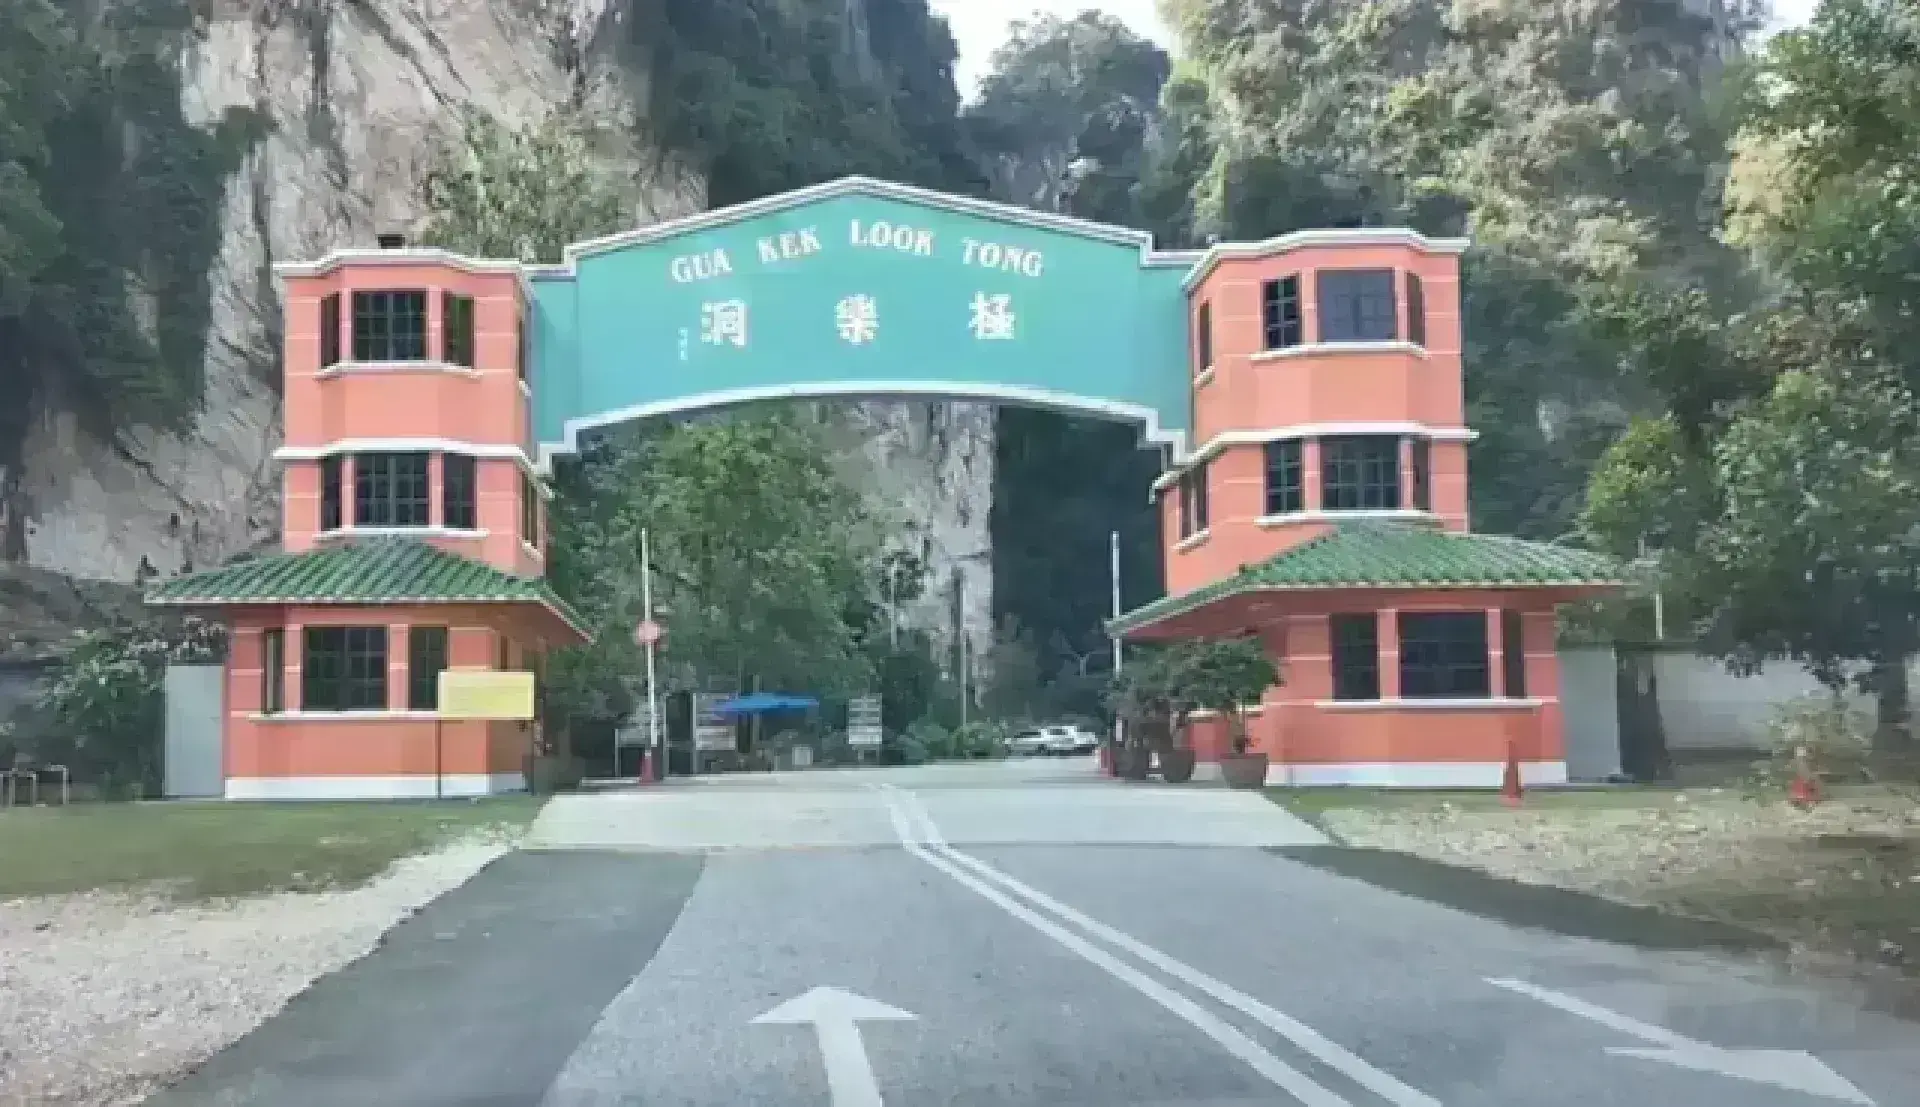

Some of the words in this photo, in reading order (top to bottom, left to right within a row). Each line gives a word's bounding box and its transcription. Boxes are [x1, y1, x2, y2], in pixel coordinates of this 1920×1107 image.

[671, 248, 733, 283] GUA
[757, 227, 823, 264] KEK
[850, 218, 935, 256] LOOK
[961, 238, 1044, 277] TONG
